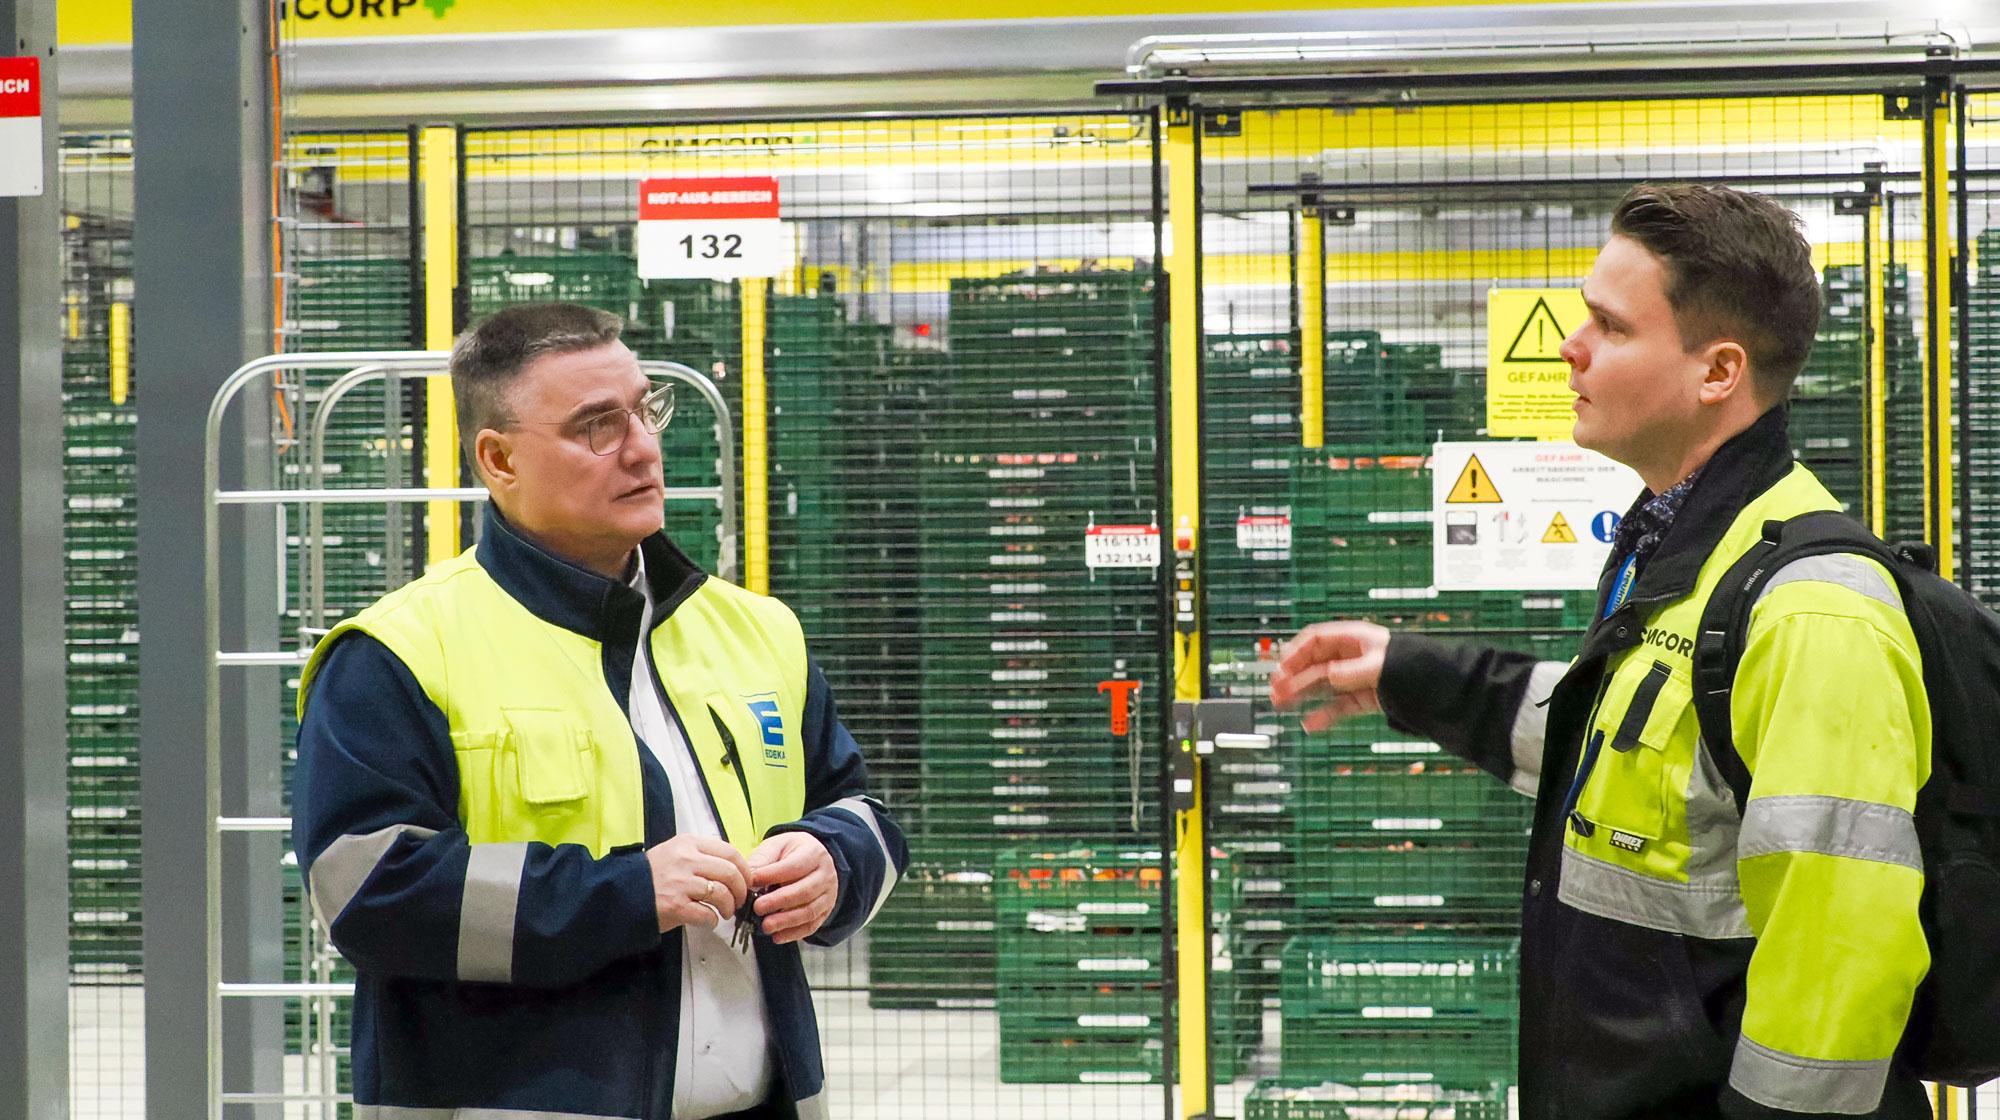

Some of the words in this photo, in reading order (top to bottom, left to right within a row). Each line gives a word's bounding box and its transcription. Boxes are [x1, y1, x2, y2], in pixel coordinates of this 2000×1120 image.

[647, 190, 773, 205] NOT-AUS-BEREICH
[679, 234, 743, 259] 132
[1507, 371, 1567, 383] GEFAHR
[765, 749, 786, 759] EDEKA
[1612, 831, 1645, 849] DIMEX
